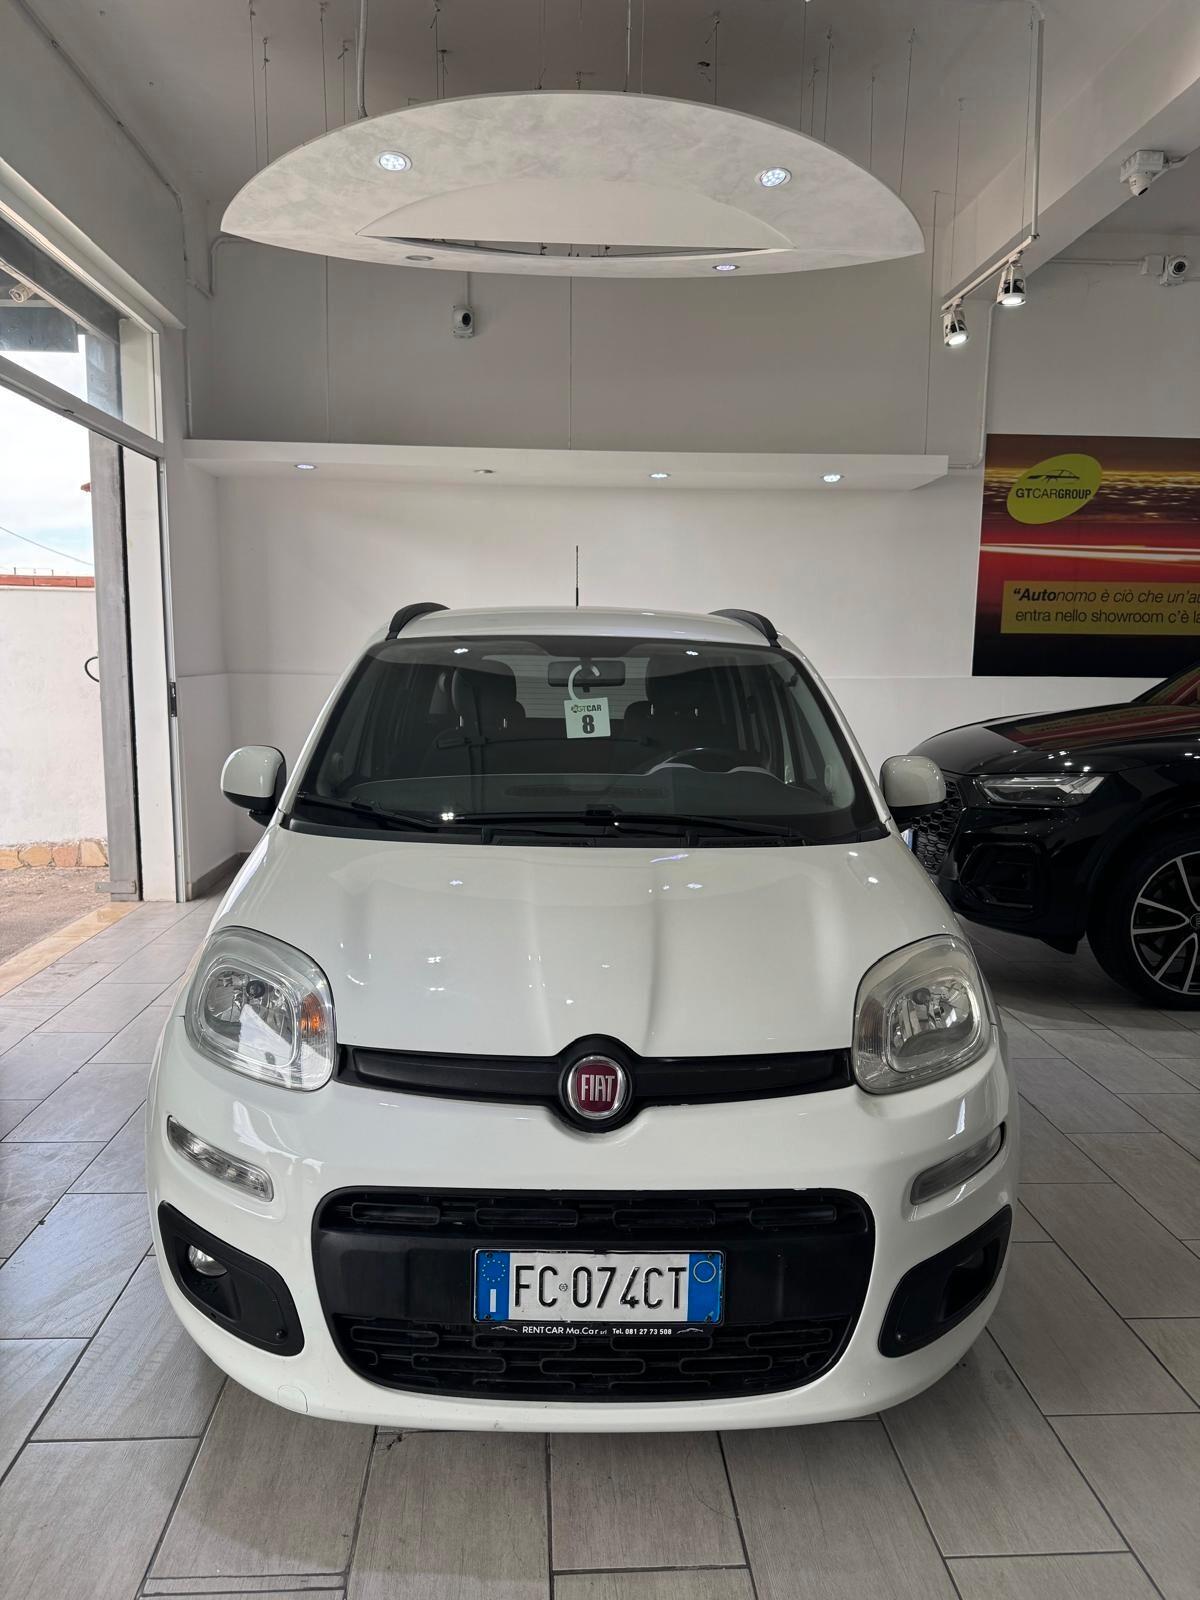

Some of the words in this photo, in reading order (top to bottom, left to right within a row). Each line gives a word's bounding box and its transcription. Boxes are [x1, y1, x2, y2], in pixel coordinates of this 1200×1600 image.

[1101, 589, 1110, 602] è
[1113, 589, 1133, 603] ciò
[1138, 590, 1164, 603] che
[1015, 609, 1050, 622] entra
[1055, 609, 1087, 623] nello
[1091, 610, 1164, 624] showroom
[582, 714, 595, 735] 8
[581, 1074, 616, 1102] FIAT
[612, 1327, 624, 1335] Tel.
